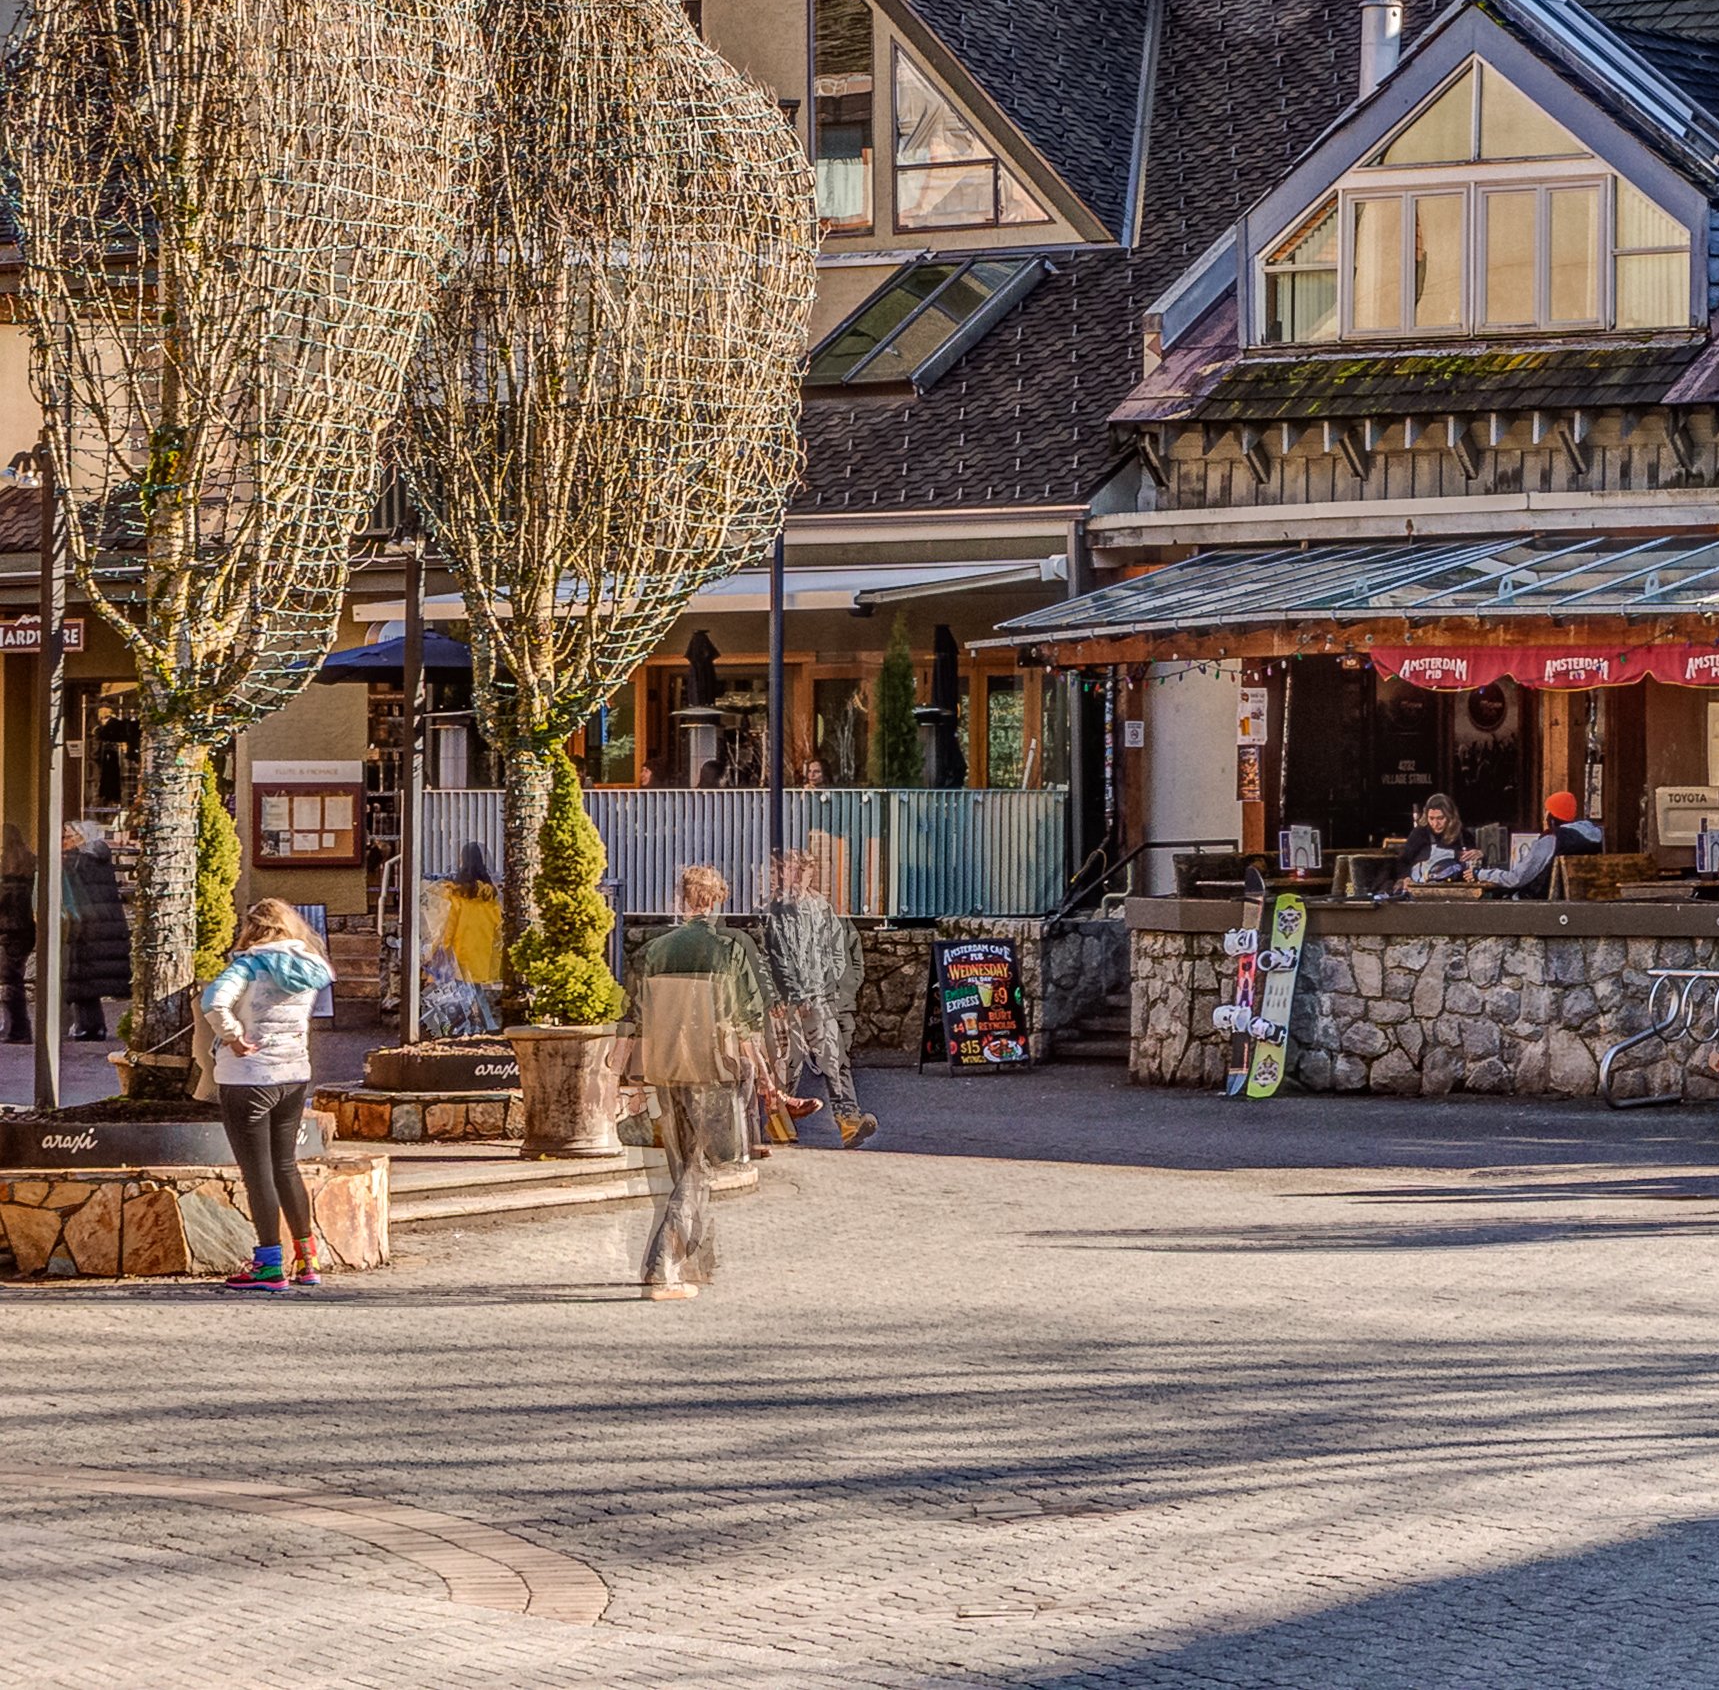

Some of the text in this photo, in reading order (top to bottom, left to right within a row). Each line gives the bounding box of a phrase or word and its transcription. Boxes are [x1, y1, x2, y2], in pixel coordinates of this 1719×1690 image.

[0, 627, 78, 647] ARDRE
[1399, 657, 1467, 681] AMSTERDAM
[1544, 657, 1609, 683] AMSTERDAM
[1668, 793, 1707, 803] TOYOTA
[943, 944, 989, 965] AMSTERDAM
[948, 963, 1009, 980] WEDNESDAY
[946, 995, 979, 1013] EXPRESS
[993, 986, 1008, 1004] $9
[988, 1011, 1011, 1021] BURT
[960, 1040, 980, 1054] $15
[42, 1127, 97, 1153] araxi
